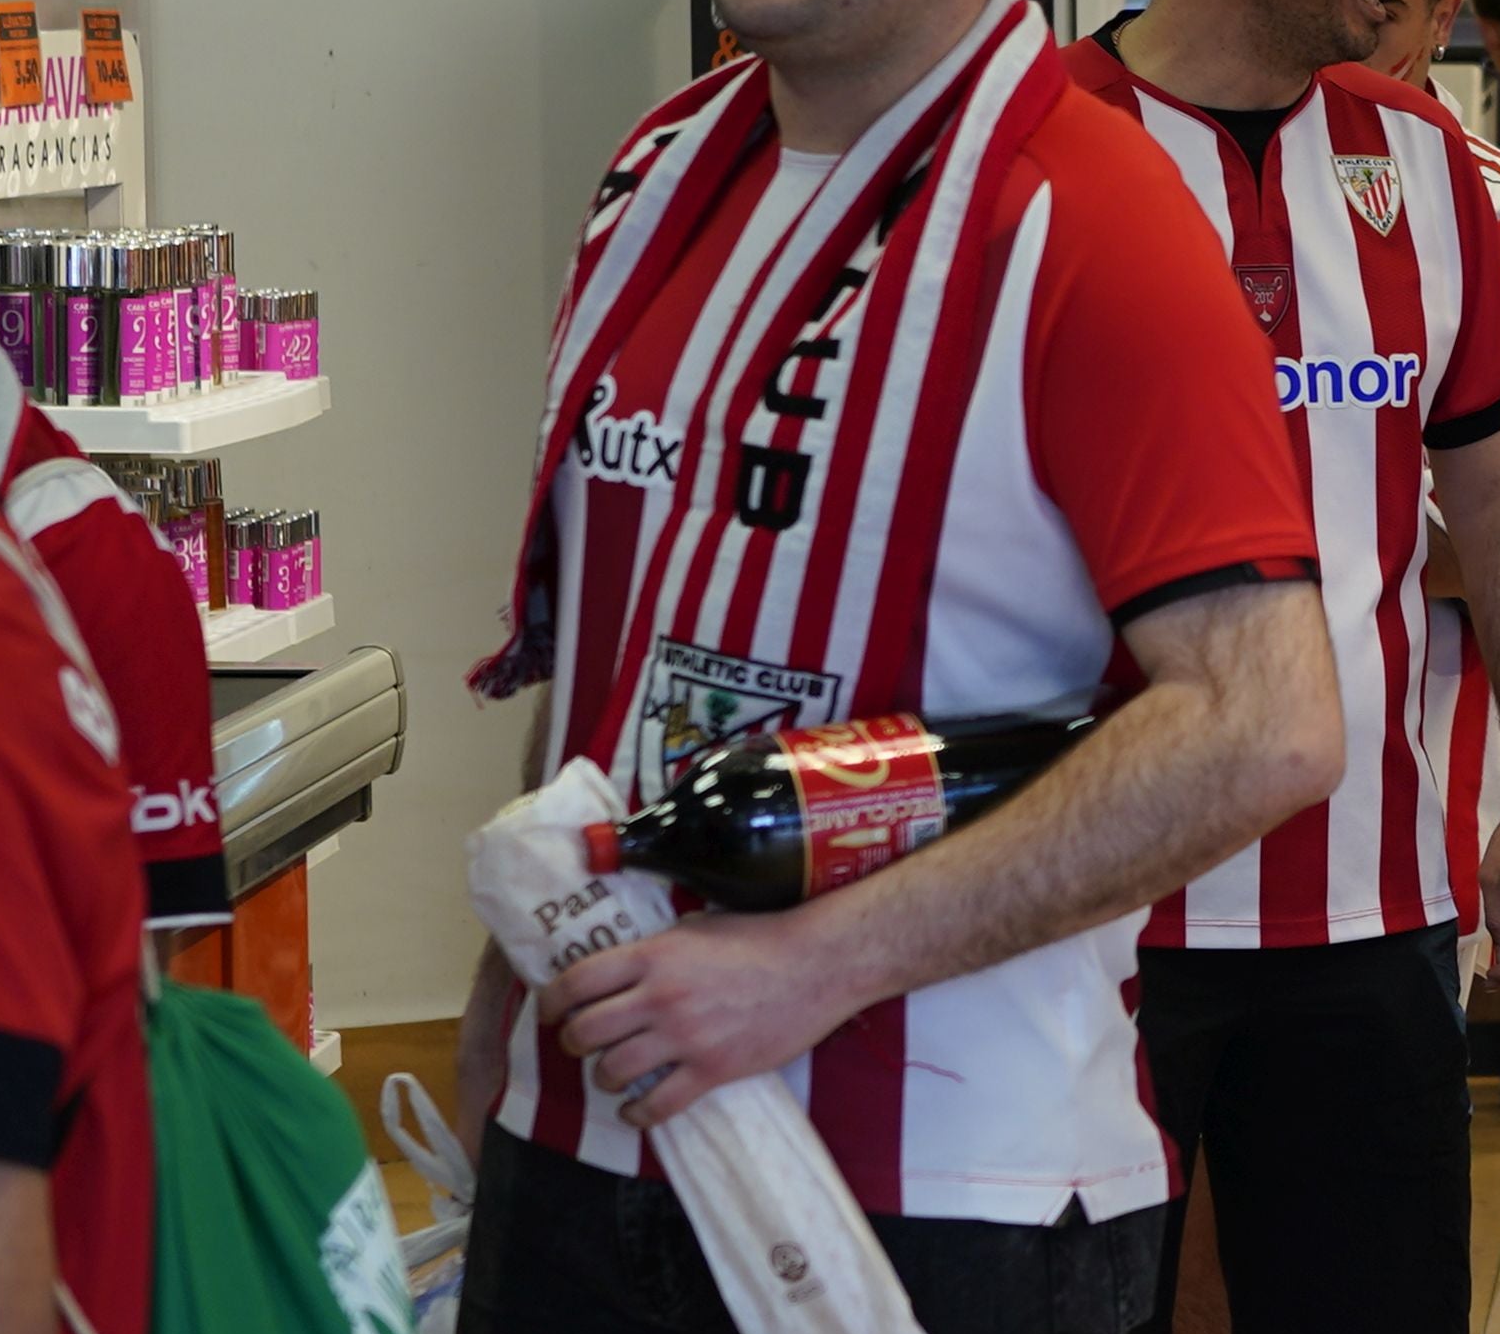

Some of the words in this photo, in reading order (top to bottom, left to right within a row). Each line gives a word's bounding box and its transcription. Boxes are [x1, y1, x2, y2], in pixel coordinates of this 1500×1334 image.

[1254, 291, 1275, 305] 2012
[1, 314, 25, 347] 9
[80, 315, 98, 354] 2
[533, 879, 612, 937] Pan
